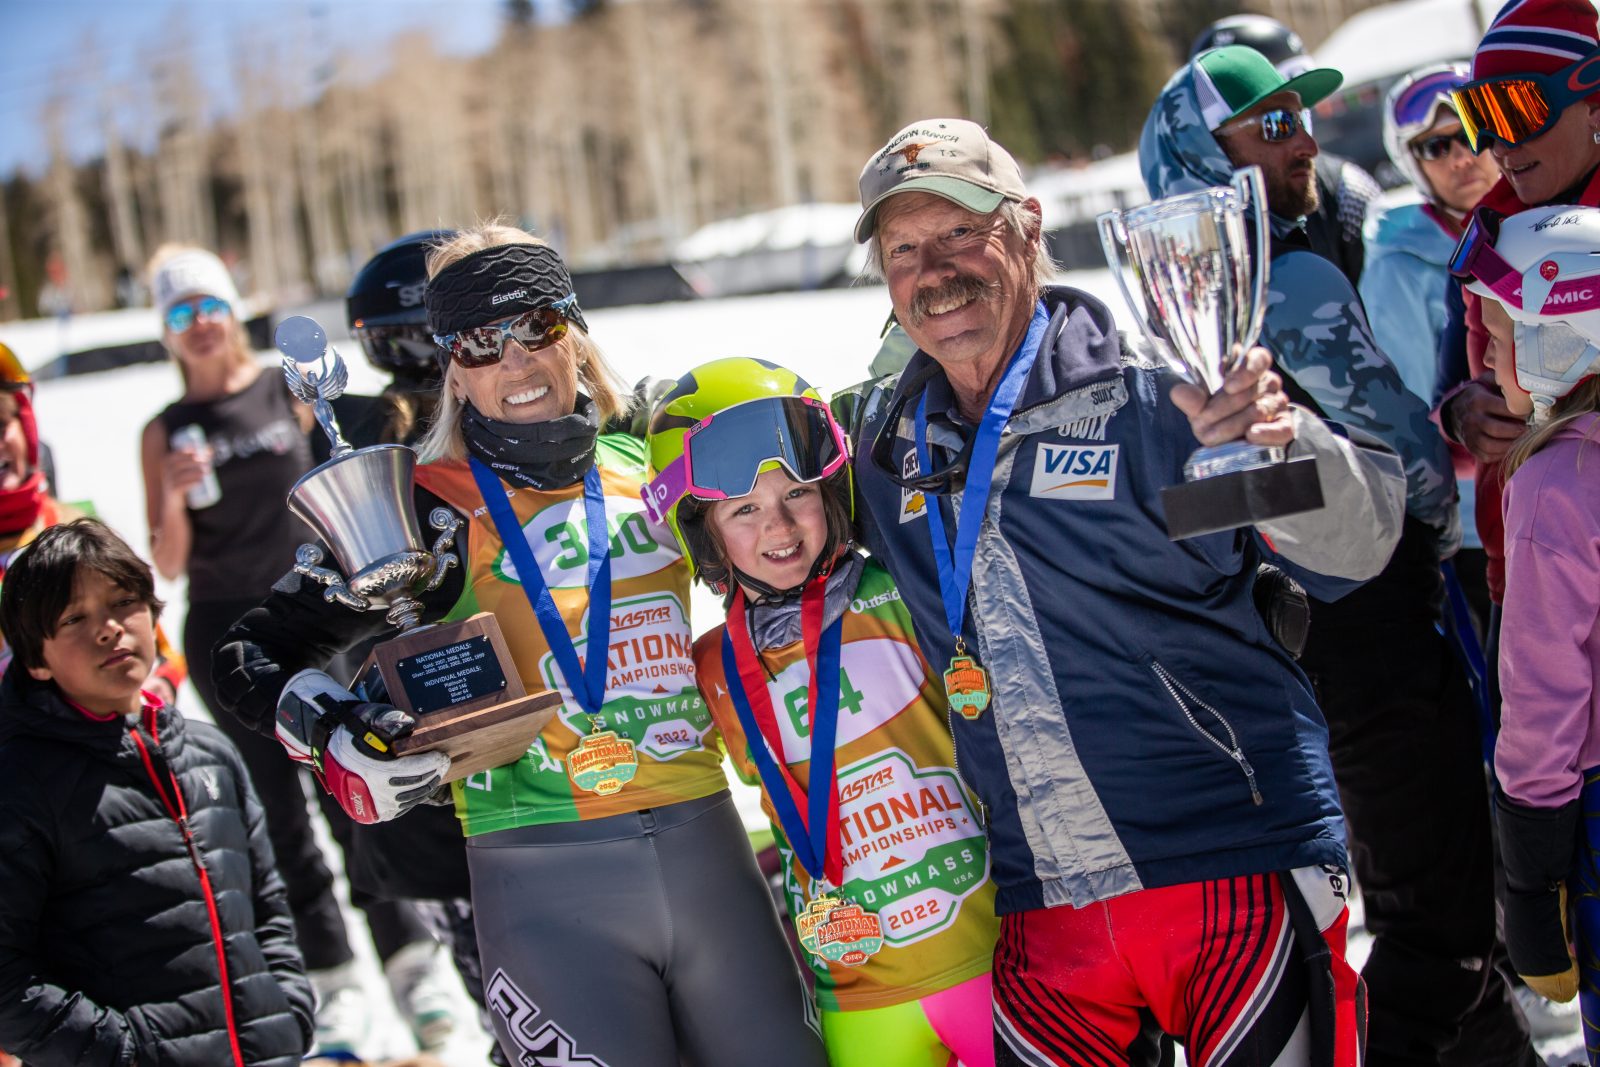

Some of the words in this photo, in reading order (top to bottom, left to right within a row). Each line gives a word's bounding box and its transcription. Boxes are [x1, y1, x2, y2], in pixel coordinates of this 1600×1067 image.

[921, 129, 960, 143] RANCH
[492, 287, 528, 305] Eisbär
[1091, 386, 1116, 406] SWIX
[1520, 377, 1561, 393] ATOMIC
[491, 461, 520, 472] HEAD
[1042, 447, 1110, 476] VISA
[514, 471, 543, 489] HEAD
[850, 586, 901, 615] Outsid
[415, 651, 446, 664] NATIONAL
[445, 642, 472, 655] MEDALS:
[424, 673, 458, 688] INDIVIDUAL
[456, 665, 482, 678] MEDALS:
[654, 729, 691, 746] 2022
[839, 766, 894, 803] ASTAR
[839, 784, 963, 847] TIONAL
[842, 817, 957, 868] AMPIONSHIPS
[953, 872, 974, 886] USA
[888, 899, 941, 931] 2022
[817, 916, 878, 938] NATIONAL
